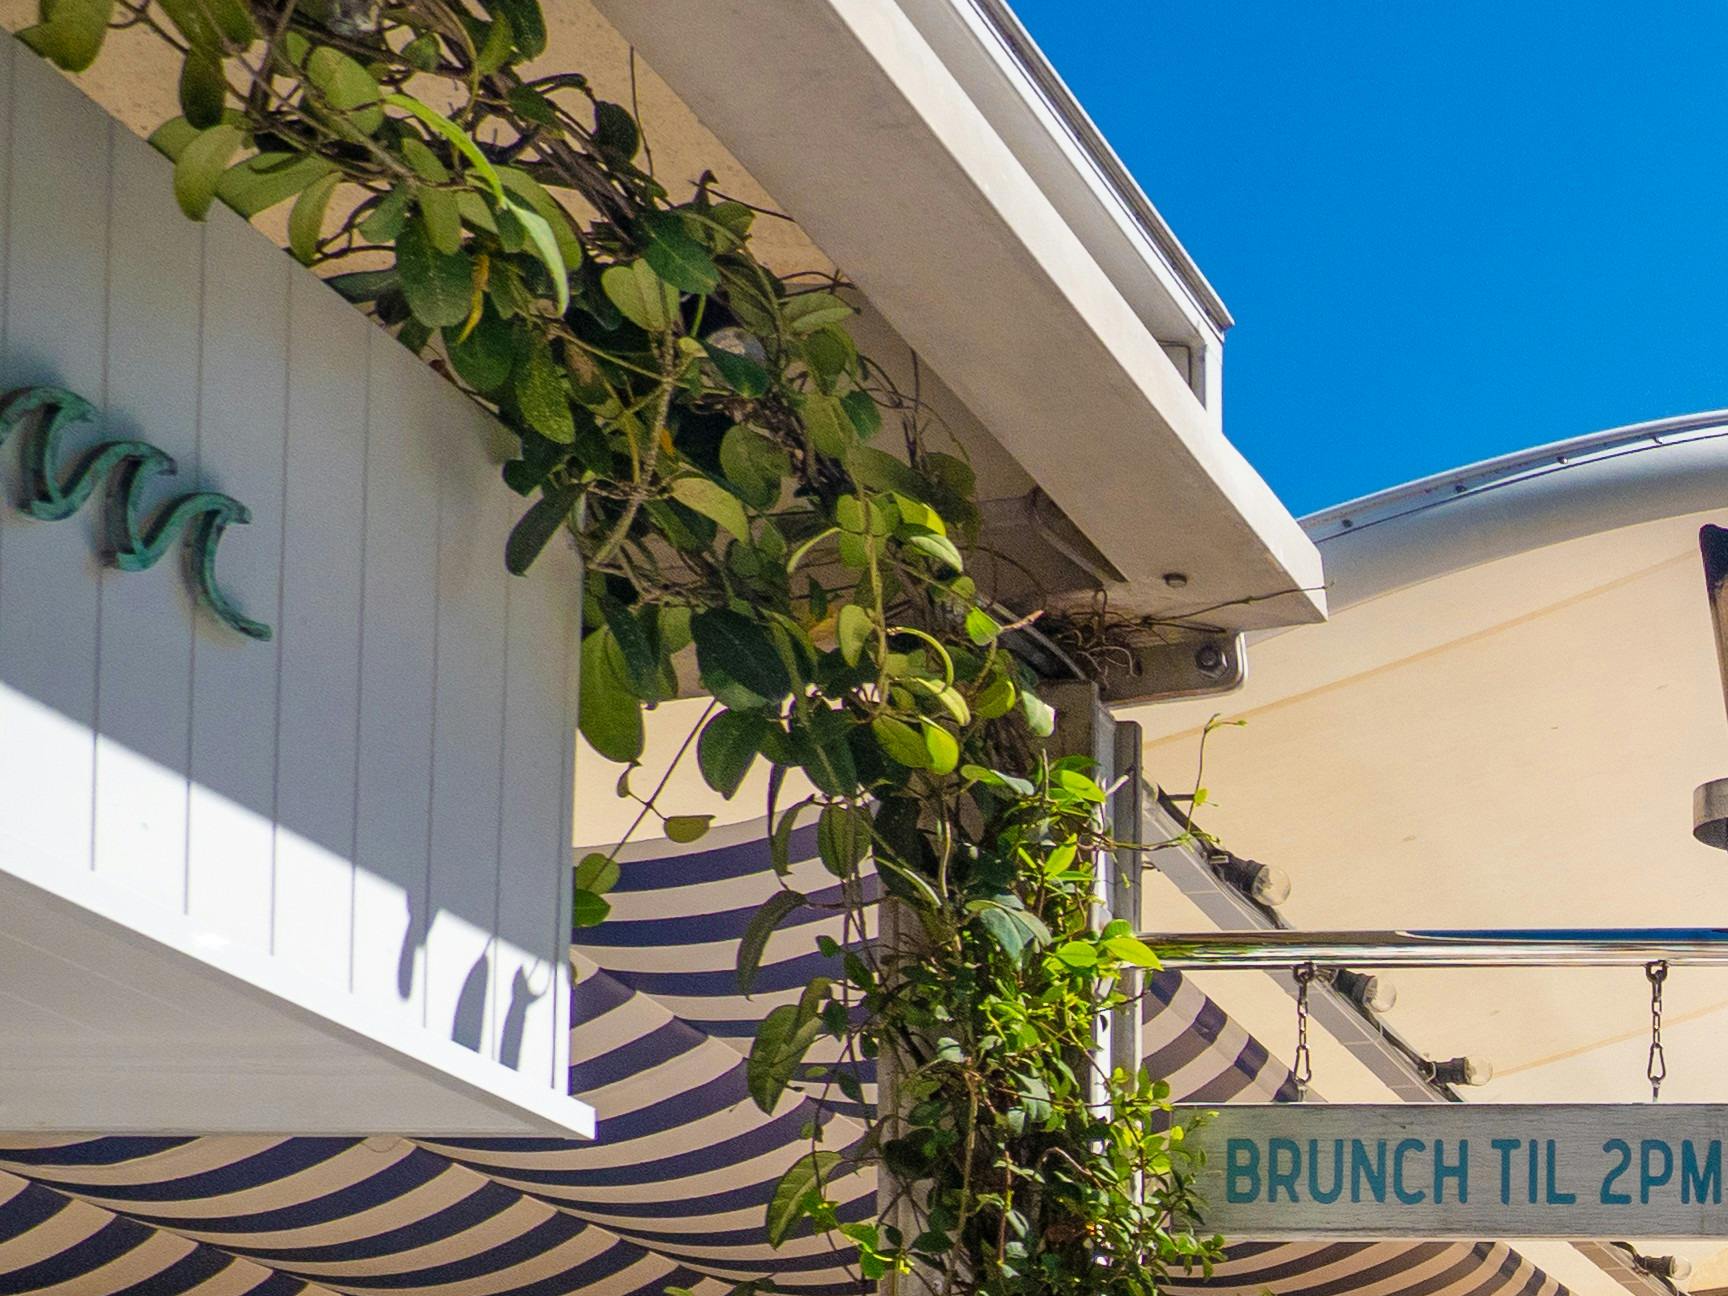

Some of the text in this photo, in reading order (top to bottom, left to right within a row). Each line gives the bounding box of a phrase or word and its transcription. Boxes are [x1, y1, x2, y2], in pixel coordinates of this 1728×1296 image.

[1225, 1138, 1722, 1206] BRUNCH TIL 2PM
